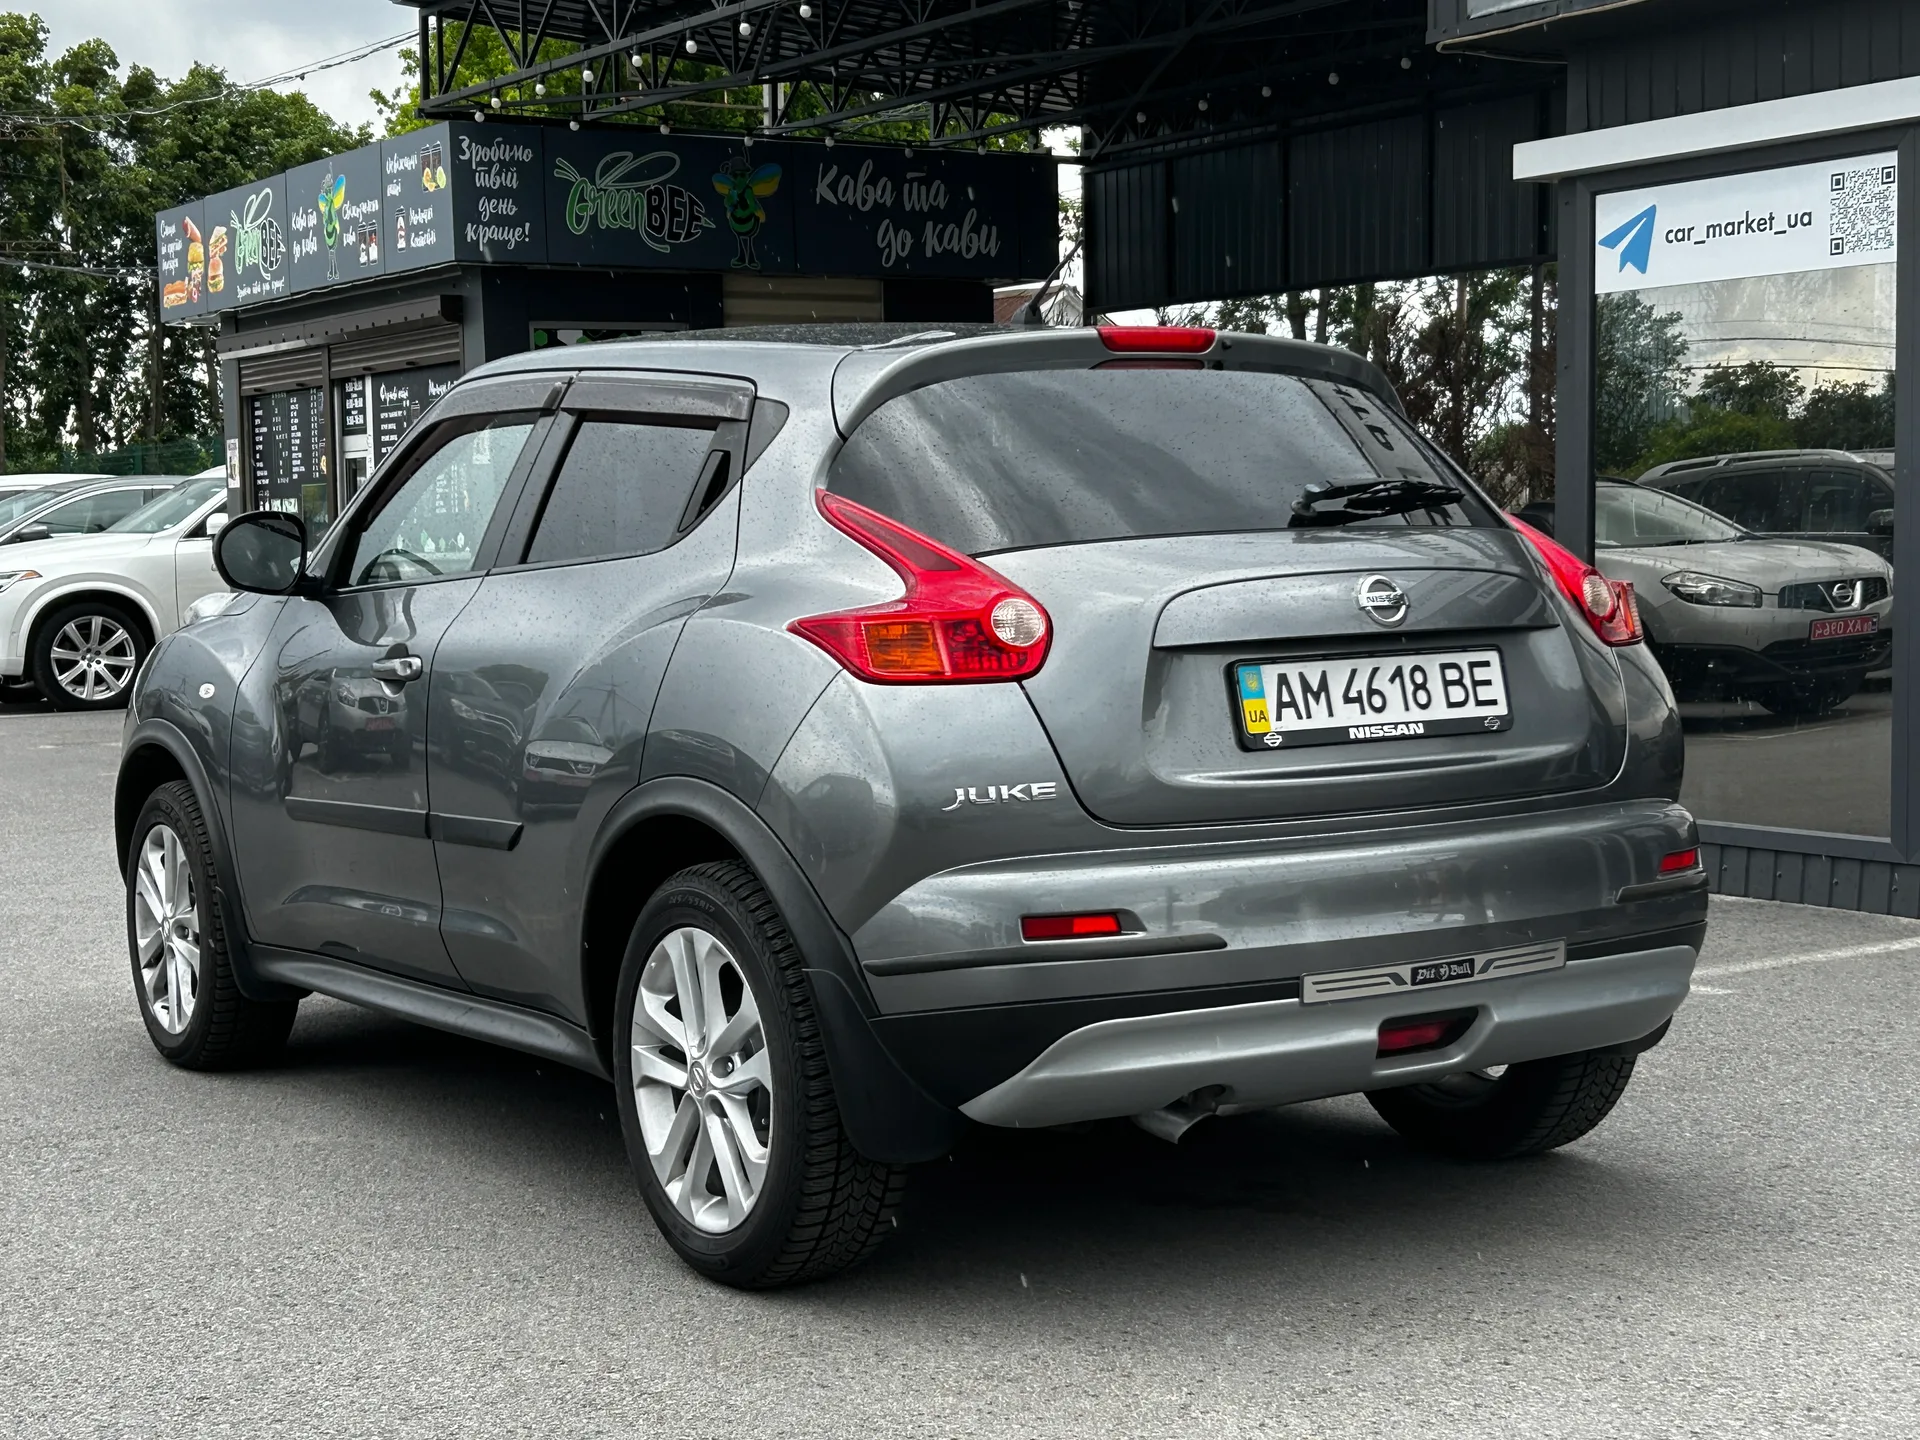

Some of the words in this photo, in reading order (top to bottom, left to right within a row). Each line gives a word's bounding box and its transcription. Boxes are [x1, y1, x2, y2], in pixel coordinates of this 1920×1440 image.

[458, 135, 534, 170] Зробимо
[475, 163, 519, 190] твій
[816, 159, 896, 212] Кава
[903, 172, 949, 213] та
[478, 195, 519, 222] день
[465, 222, 531, 252] краще!
[877, 219, 914, 268] до
[921, 208, 1001, 260] кави
[1665, 210, 1812, 245] car_market_ua
[1275, 670, 1334, 722] AM
[1342, 665, 1432, 715] 4618
[1439, 660, 1498, 709] BE
[1249, 710, 1269, 724] UA
[1349, 722, 1425, 740] NISSAN
[941, 782, 1057, 812] JUKE
[1415, 967, 1436, 983] Pit
[1450, 962, 1472, 976] Bull
